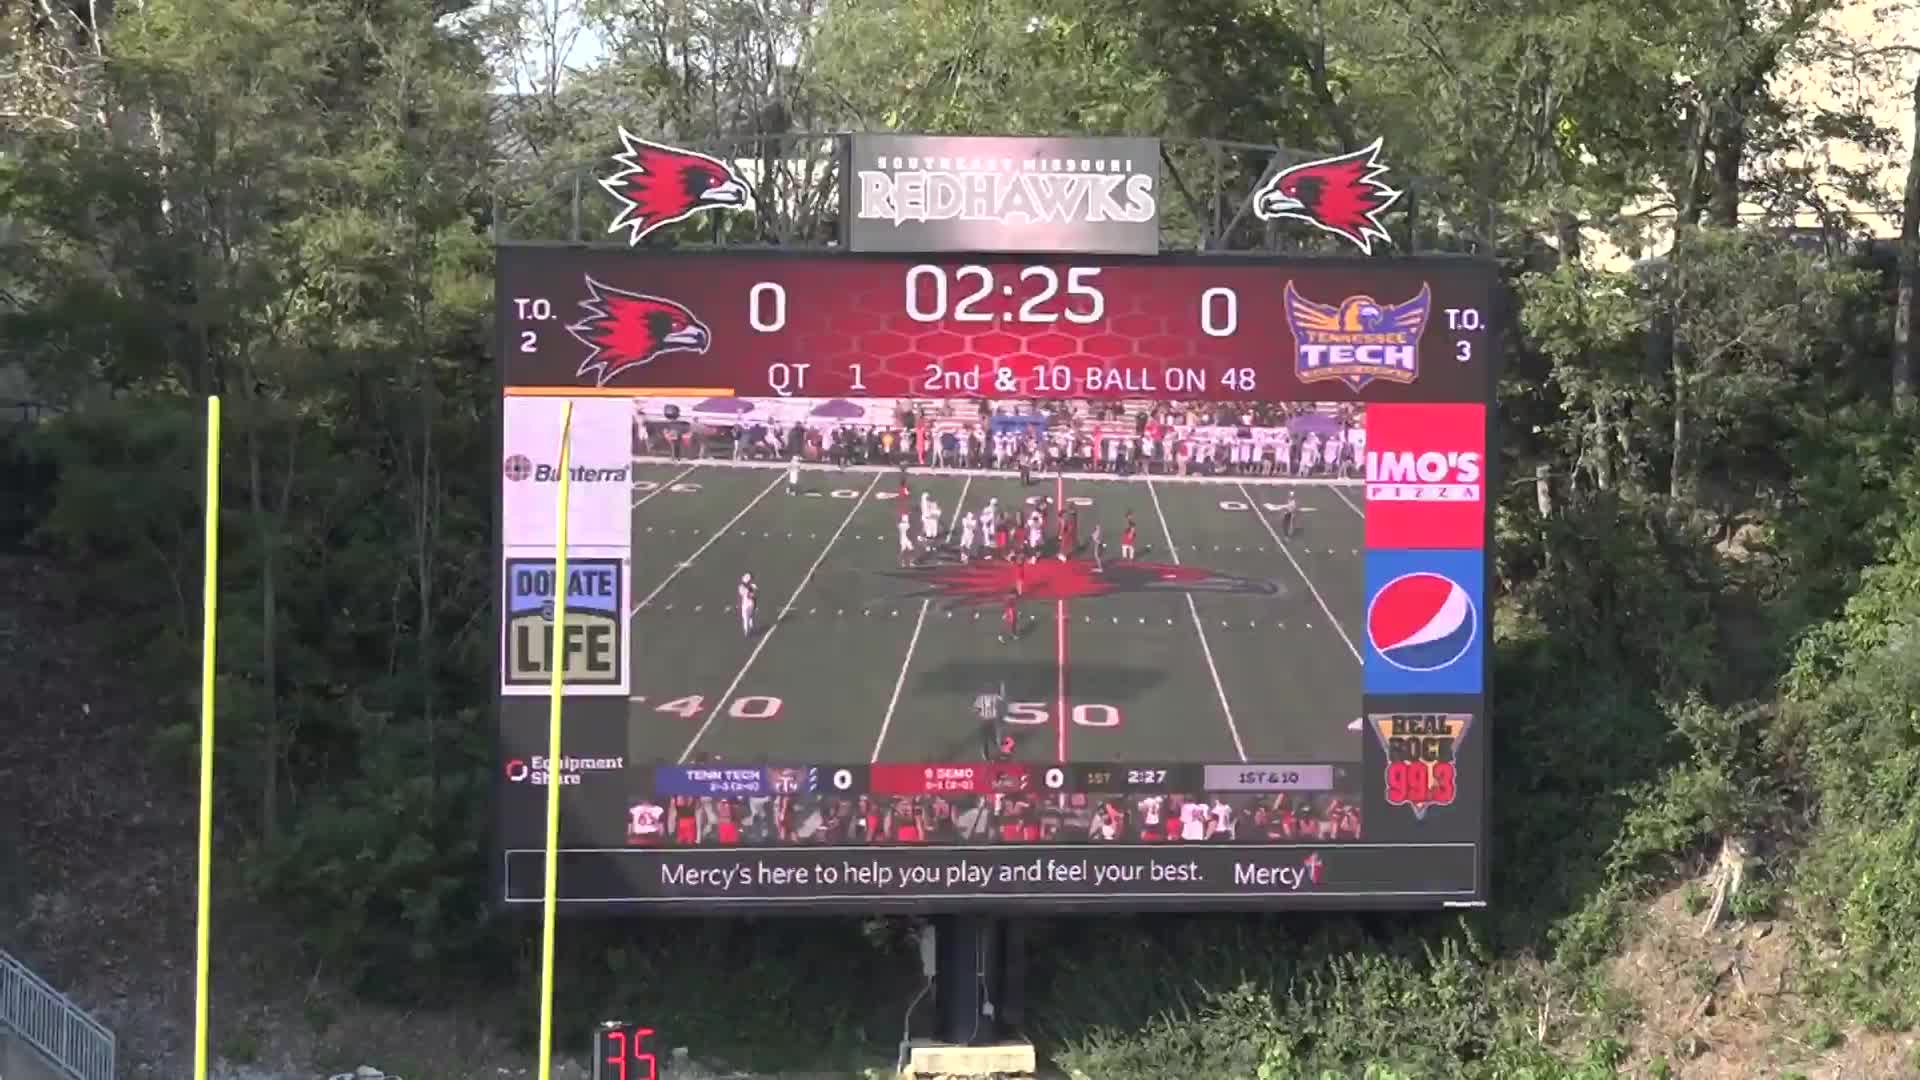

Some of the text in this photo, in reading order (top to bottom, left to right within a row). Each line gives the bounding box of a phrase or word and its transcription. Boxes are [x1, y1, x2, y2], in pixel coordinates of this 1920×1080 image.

[1023, 160, 1132, 172] MISSOURI
[858, 171, 1156, 226] REDHAWKS
[905, 264, 1104, 323] 02:25
[513, 298, 557, 320] T.O.
[750, 282, 786, 332] 0
[1201, 287, 1238, 337] 0
[1444, 308, 1485, 330] T.O.
[520, 331, 537, 352] 2
[1305, 331, 1408, 344] TENNESSEE
[1300, 344, 1416, 369] TECH
[1456, 340, 1471, 362] 3
[768, 363, 1256, 396] QT 1 2nd & 10 BALL ON 48
[1367, 451, 1481, 482] IMO'S
[1371, 487, 1474, 498] PIZZA
[517, 625, 611, 672] LIFE
[1391, 716, 1452, 735] REAL
[687, 770, 760, 781] TENN TECH
[833, 769, 853, 790] 0
[1045, 768, 1065, 789] 0
[1127, 769, 1168, 785] 2:27
[661, 859, 1204, 890] Mercy's here to help you play and feel your best.
[1234, 863, 1305, 890] Mercy
[607, 1028, 657, 1080] 35
